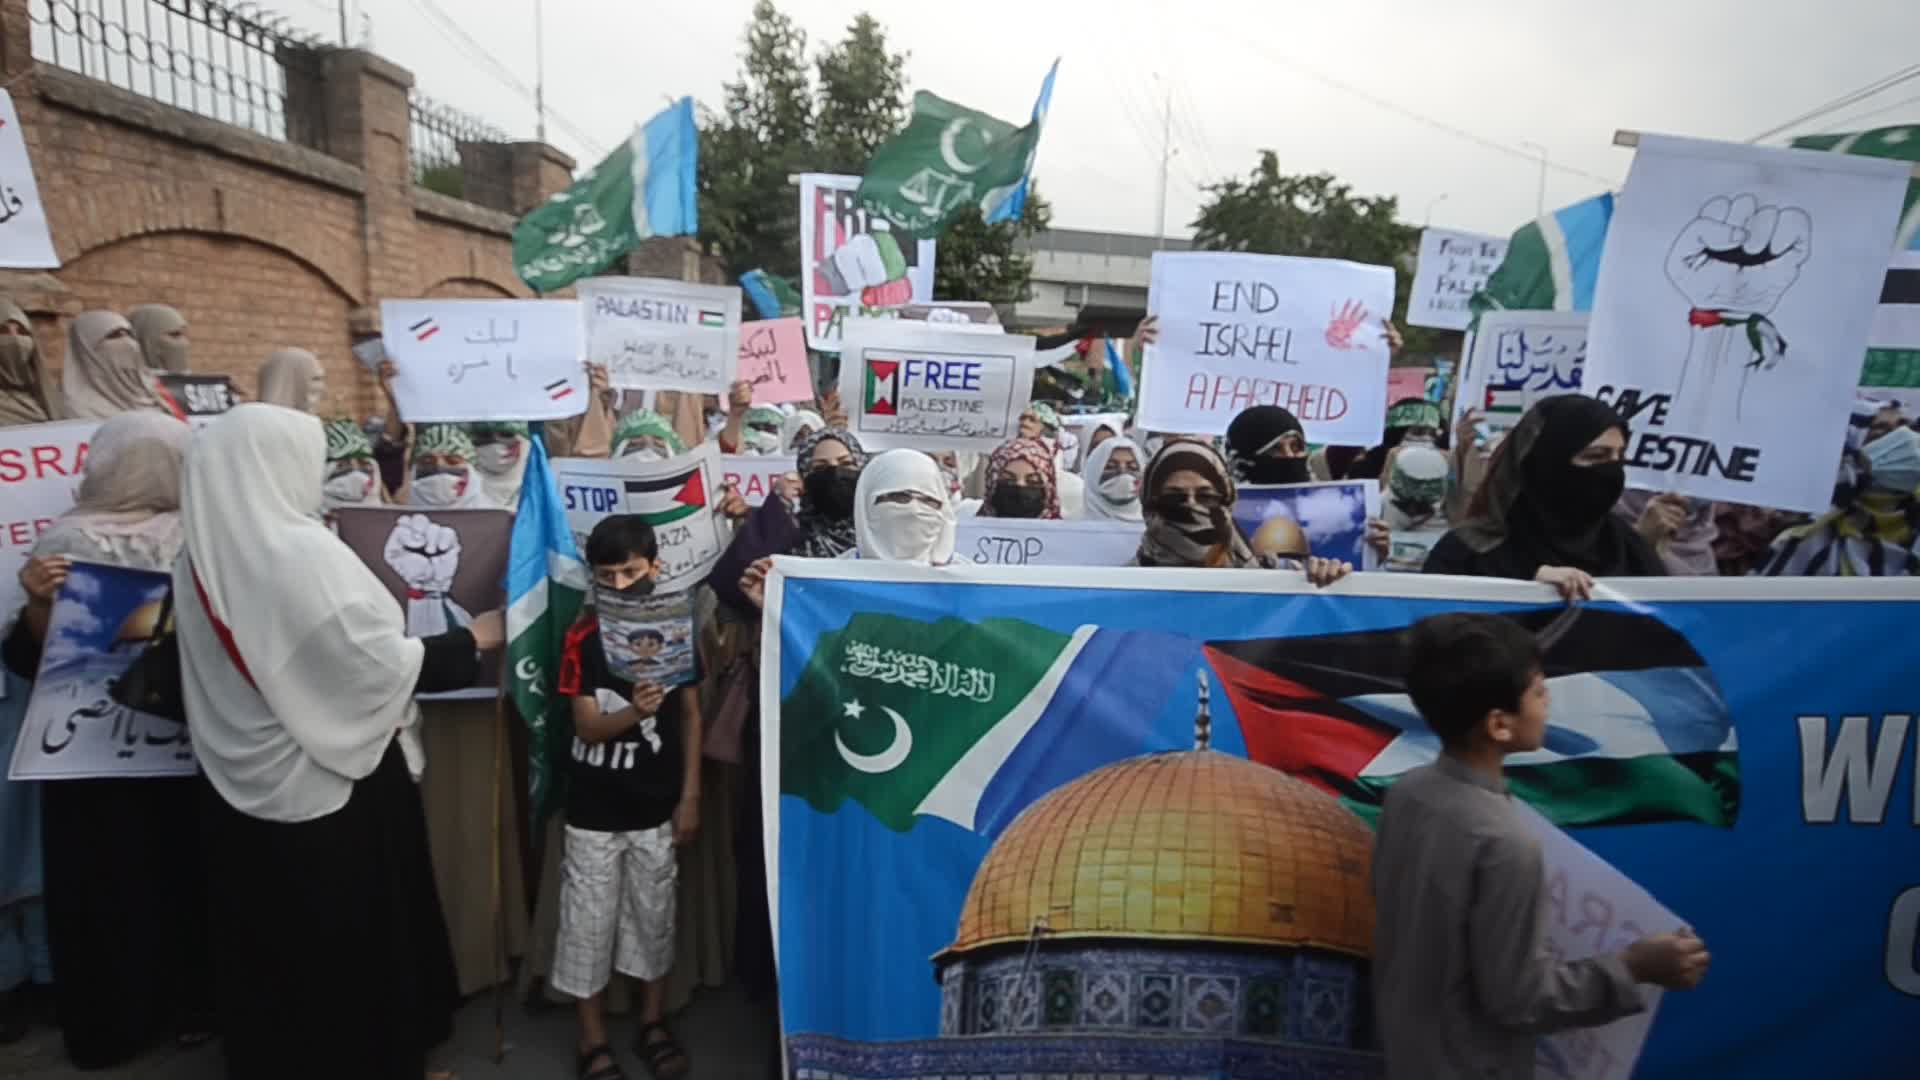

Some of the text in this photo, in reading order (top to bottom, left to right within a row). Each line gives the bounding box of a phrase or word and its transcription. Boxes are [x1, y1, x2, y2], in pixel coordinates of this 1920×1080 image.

[594, 295, 689, 325] PALASTIN
[1212, 279, 1279, 313] END
[1194, 321, 1300, 365] ISRAEL
[904, 360, 981, 391] FREE
[901, 397, 984, 413] PALESTINE
[1184, 371, 1348, 421] APARTHEID
[1622, 430, 1760, 481] LESTINE
[565, 486, 618, 512] STOP
[660, 525, 692, 549] AZA
[973, 536, 1044, 565] STOP
[611, 741, 640, 769] IT
[1797, 713, 1920, 826] W
